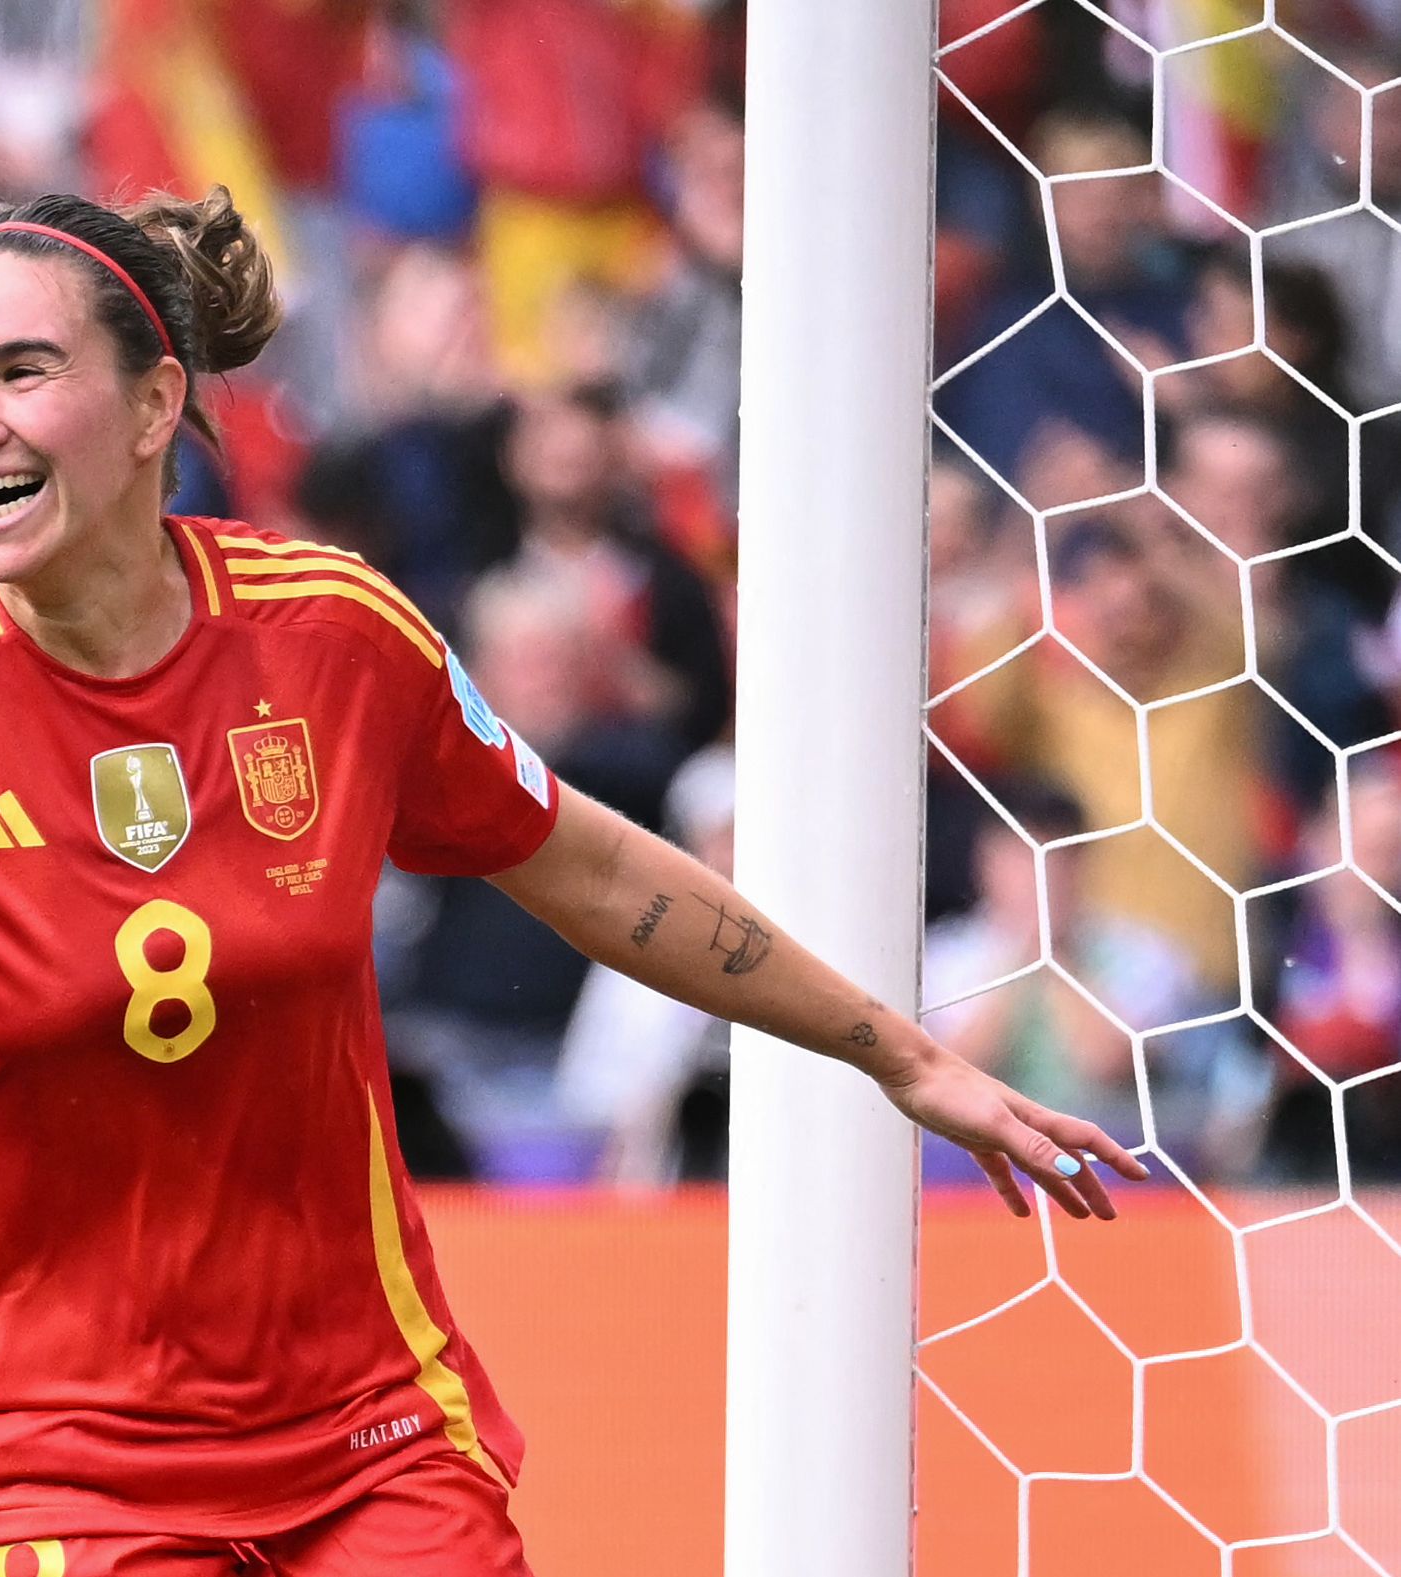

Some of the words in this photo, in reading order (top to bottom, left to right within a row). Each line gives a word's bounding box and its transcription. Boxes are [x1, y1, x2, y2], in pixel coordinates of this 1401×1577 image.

[125, 820, 168, 841] FIFA
[114, 898, 217, 1064] 8
[350, 1413, 421, 1451] HEAT.RDY
